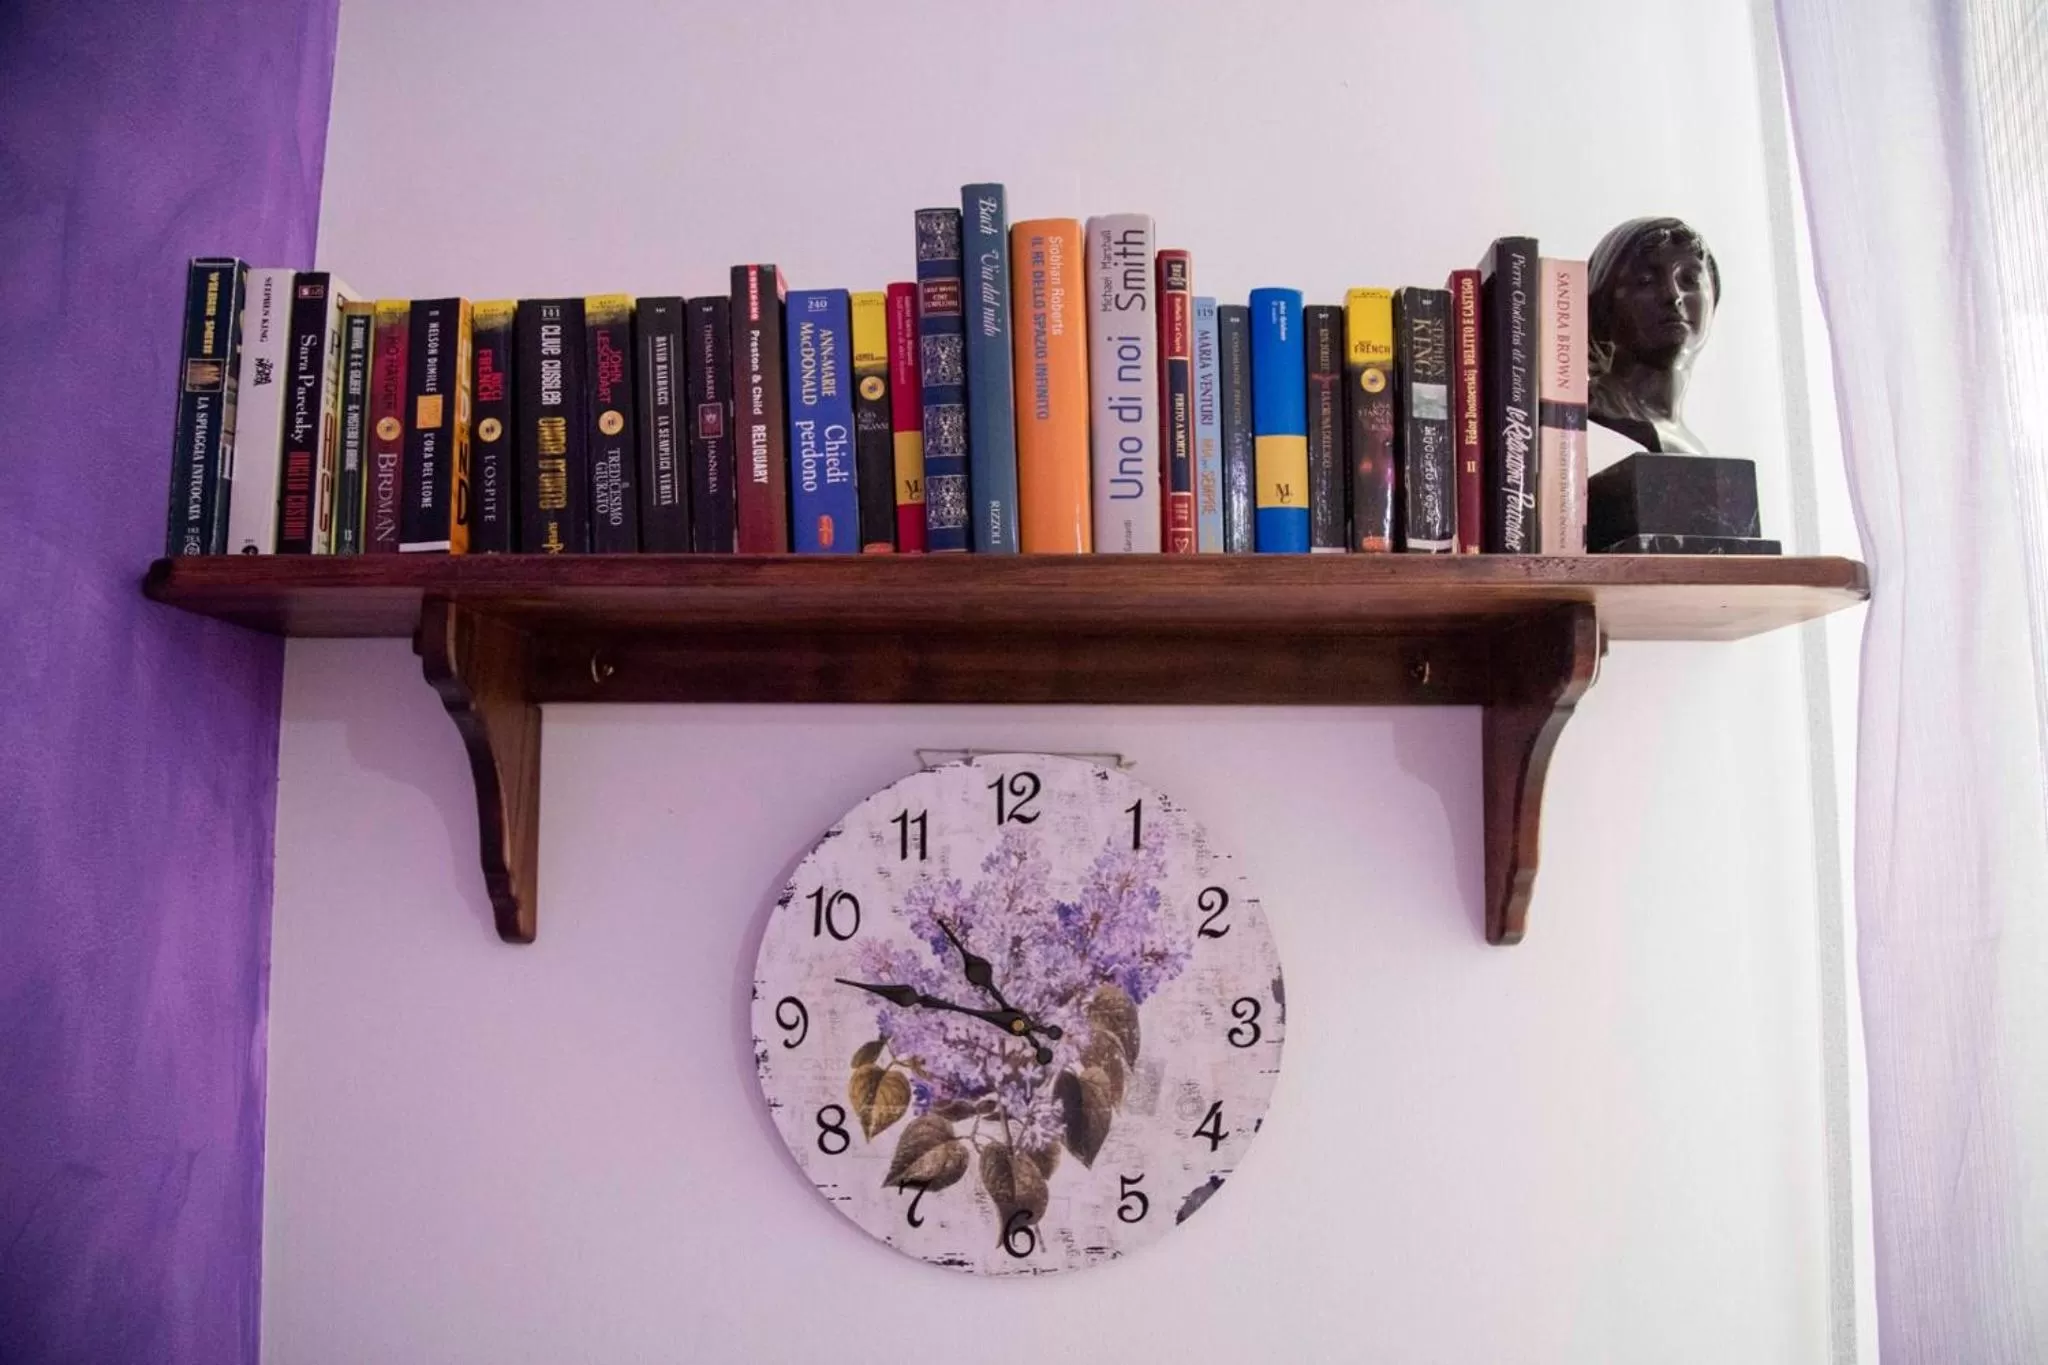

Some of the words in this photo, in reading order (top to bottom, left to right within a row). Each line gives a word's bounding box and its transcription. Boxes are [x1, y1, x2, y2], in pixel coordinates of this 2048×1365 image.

[978, 196, 998, 235] Bach
[981, 249, 999, 279] Via
[1032, 236, 1044, 247] IL
[1032, 251, 1044, 266] RE
[1049, 236, 1064, 285] Siobhan
[1100, 230, 1112, 269] Marshall
[1032, 270, 1046, 308] DELLO
[1113, 230, 1147, 311] Smith
[1511, 252, 1526, 287] Pierre
[205, 272, 220, 316] WILBUR
[262, 276, 273, 316] STEPHEN
[808, 300, 827, 308] 240
[982, 282, 1000, 306] dal
[1052, 288, 1066, 336] Roberts
[1100, 276, 1113, 312] Michael
[1461, 278, 1474, 317] CASTIGO
[1511, 289, 1528, 346] Choderlos
[1555, 272, 1571, 331] SANDRA
[203, 320, 216, 354] SMITH
[259, 318, 269, 342] KING
[427, 322, 439, 355] NELSON
[703, 323, 716, 364] THOMAS
[983, 308, 1002, 337] nido
[1034, 314, 1048, 358] SPAZIO
[1462, 326, 1475, 365] DELITTO
[298, 334, 317, 371] Sara
[596, 329, 612, 404] LESCROART
[609, 348, 623, 383] JOHN
[749, 330, 761, 371] Preston
[820, 329, 836, 397] ANN-MARIE
[1106, 335, 1141, 382] noi
[1198, 329, 1213, 369] MARIA
[1411, 318, 1433, 377] KING
[1431, 317, 1446, 378] STEPHEN
[1511, 348, 1526, 363] de
[1555, 334, 1572, 390] BROWN
[478, 348, 494, 401] FRENCH
[541, 360, 561, 405] CUSSLER
[705, 366, 716, 400] HARRIS
[751, 374, 761, 383] &
[1034, 363, 1050, 420] INFINITO
[1462, 369, 1478, 418] Dostoevskij
[1511, 365, 1526, 402] Laclos
[196, 396, 210, 409] LA
[290, 375, 315, 442] Paretsky
[752, 386, 764, 415] Child
[1107, 396, 1142, 423] di
[1174, 393, 1185, 421] FERITO
[1199, 374, 1214, 426] VENTURI
[193, 413, 208, 460] SPIAGGIA
[423, 433, 435, 458] L'ORA
[538, 417, 567, 454] ONDA
[751, 424, 768, 484] RELIQUARY
[796, 420, 824, 492] perdono
[824, 424, 848, 484] Chiedi
[1176, 431, 1186, 458] MORTE
[1502, 418, 1533, 483] Relazioni
[422, 462, 433, 477] DEL
[483, 455, 497, 522] L'OSPITE
[595, 462, 609, 514] GIURATO
[608, 448, 623, 526] TREDICESIMO
[706, 441, 718, 494] HANNIBAL
[1108, 436, 1144, 499] Uno
[188, 464, 204, 521] INFUOCATA
[376, 453, 398, 541] BIRDMAN
[421, 481, 433, 508] LEONE
[1202, 470, 1217, 515] SEMPRE
[990, 500, 1001, 545] RIZZOLI
[1501, 487, 1535, 551] Pericolose
[988, 772, 1041, 825] 12
[890, 809, 928, 861] 11
[1124, 799, 1142, 850] 1
[806, 886, 861, 941] 10
[1197, 886, 1231, 939] 2
[775, 996, 809, 1049] 9
[1227, 996, 1262, 1048] 3
[816, 1104, 850, 1155] 8
[1192, 1100, 1230, 1152] 4
[897, 1180, 929, 1228] 7
[1117, 1173, 1150, 1223] 5
[1003, 1210, 1035, 1258] 6
